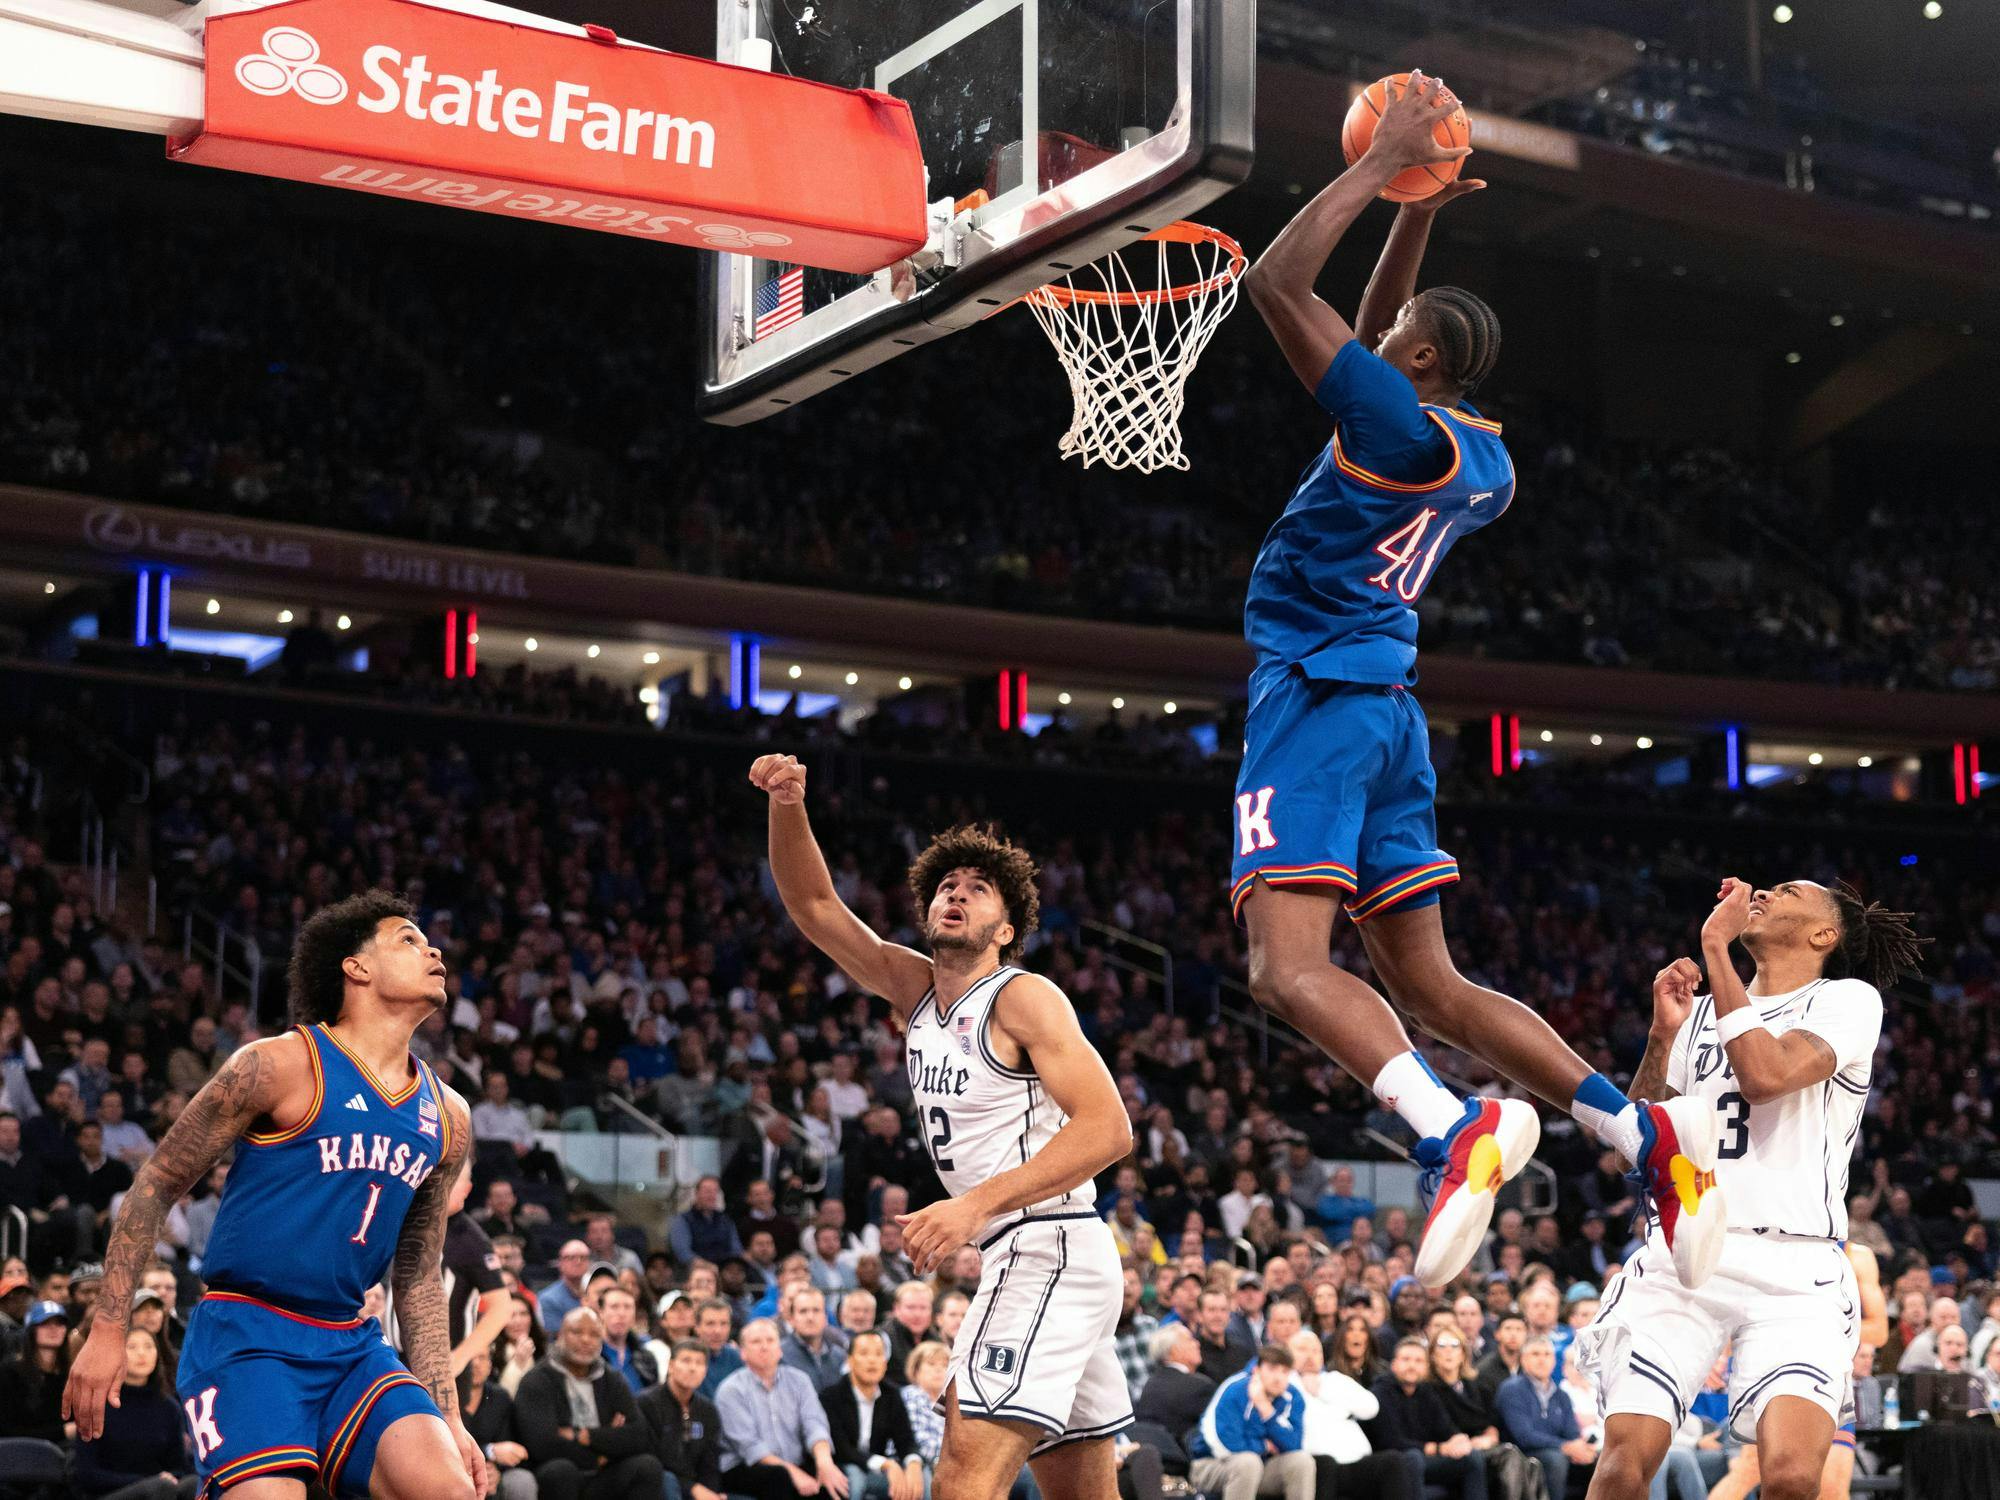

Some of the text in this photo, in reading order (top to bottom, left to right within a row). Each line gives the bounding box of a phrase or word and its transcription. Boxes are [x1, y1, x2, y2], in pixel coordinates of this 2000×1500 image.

[146, 525, 312, 568] LEXUS
[362, 552, 529, 599] SUITE LEVEL
[1366, 506, 1455, 603] 40
[1236, 785, 1278, 857] K
[909, 1047, 970, 1097] Duke
[919, 1104, 956, 1172] 12
[1717, 1091, 1751, 1160] 3
[351, 1183, 384, 1246] 1
[184, 1385, 225, 1463] K
